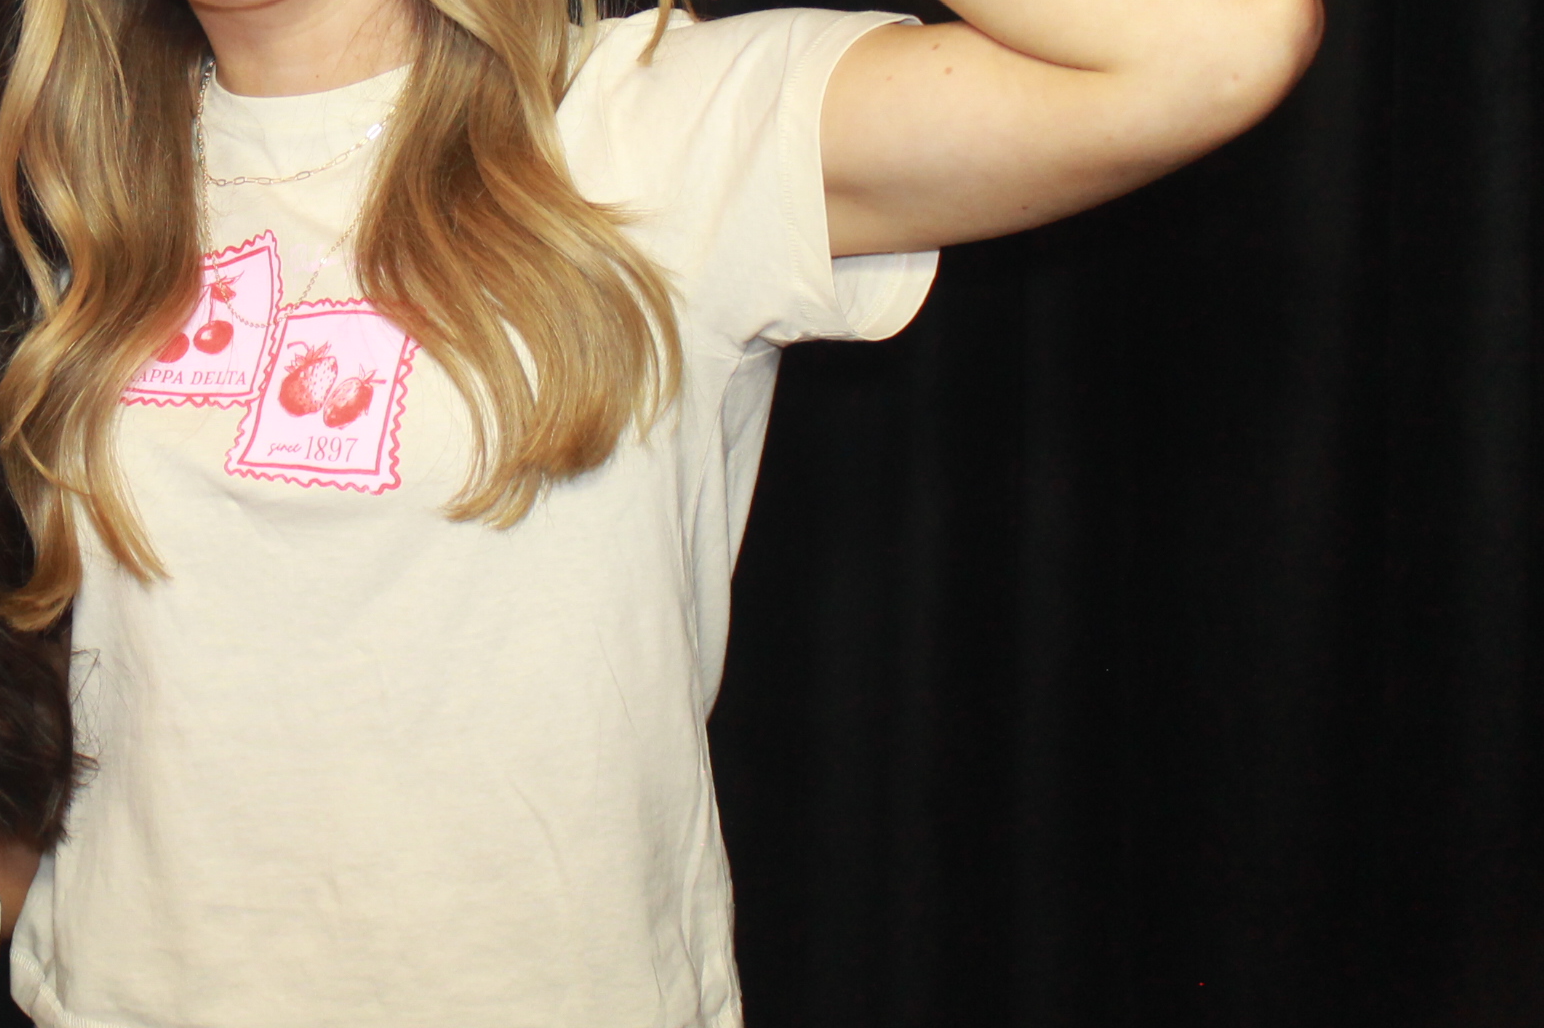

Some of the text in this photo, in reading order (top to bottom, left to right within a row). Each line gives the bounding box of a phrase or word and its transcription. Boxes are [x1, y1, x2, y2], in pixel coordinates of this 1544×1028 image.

[190, 370, 247, 386] DELTA
[267, 435, 359, 463] since 1897
